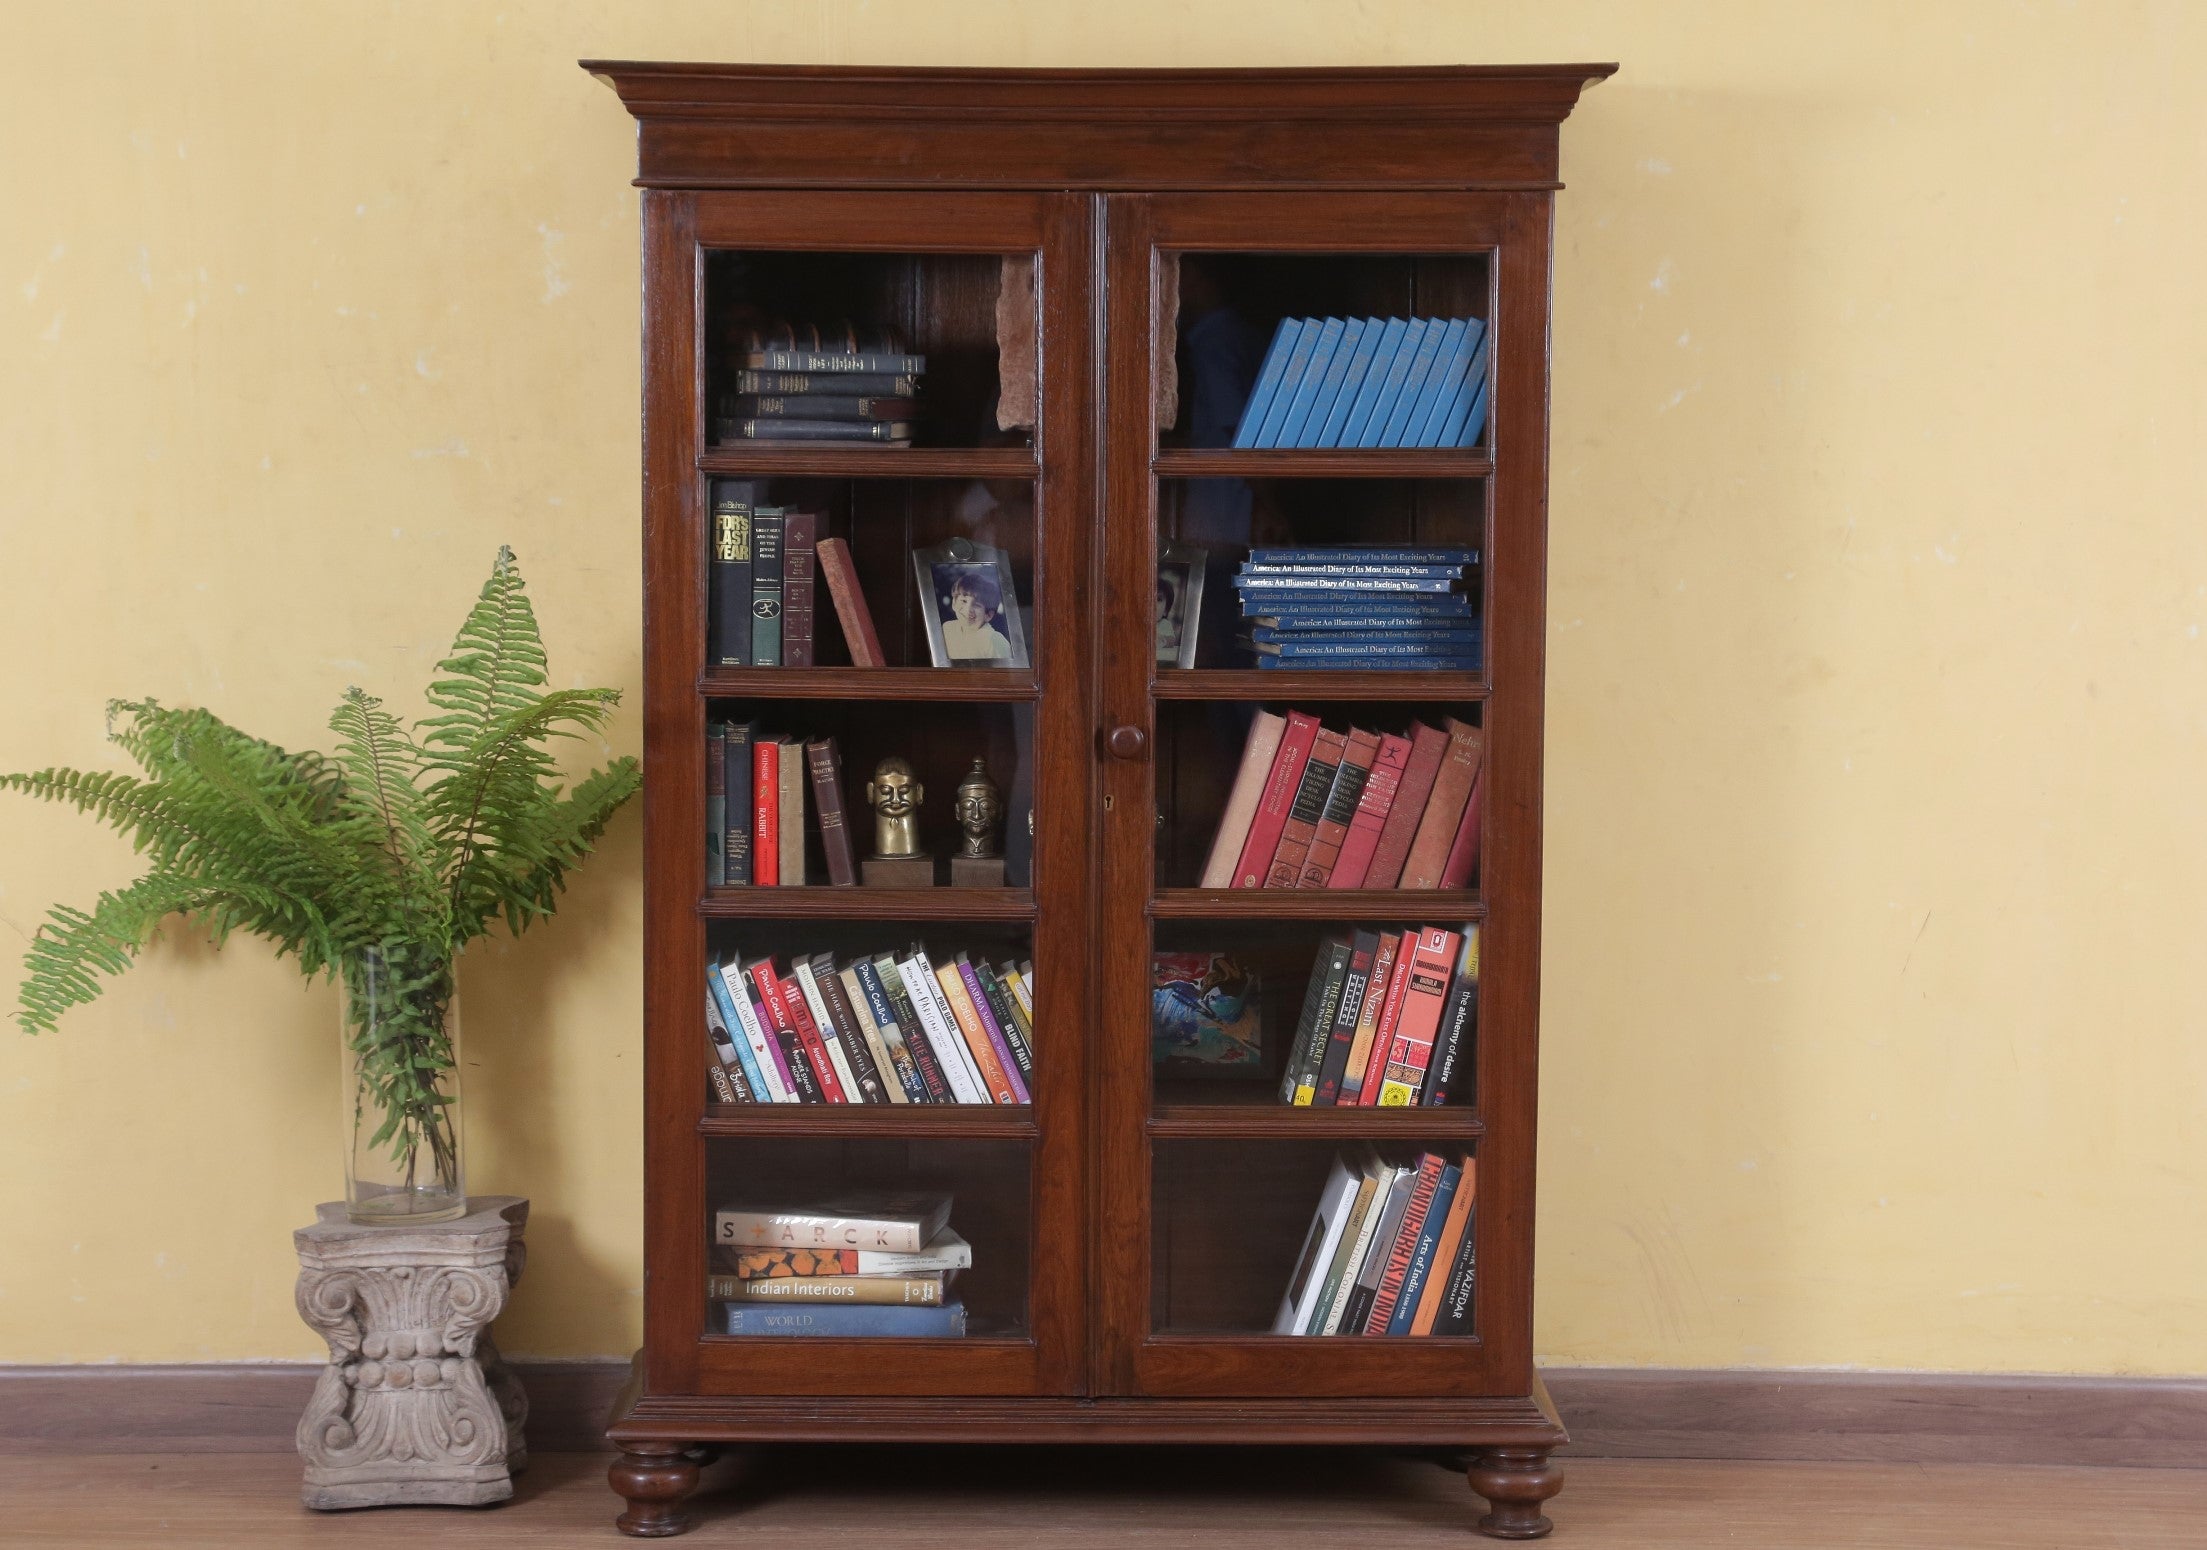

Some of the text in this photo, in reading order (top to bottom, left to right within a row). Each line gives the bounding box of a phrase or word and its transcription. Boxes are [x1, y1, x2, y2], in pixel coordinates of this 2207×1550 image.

[715, 514, 749, 530] FDR's
[727, 501, 747, 510] Bishop
[715, 530, 749, 545] LAST
[715, 544, 749, 560] YEAR
[1252, 564, 1281, 572] America:
[1282, 564, 1292, 572] An
[1293, 564, 1326, 572] Illustrated
[1327, 565, 1346, 575] Diary
[1346, 565, 1355, 573] of
[1355, 565, 1364, 573] Its
[1365, 565, 1382, 573] Most
[1383, 566, 1410, 576] Exciting
[1285, 579, 1318, 587] Illustrated
[1319, 580, 1338, 589] Diary
[1338, 580, 1347, 588] of
[1346, 580, 1356, 588] Its
[1374, 581, 1401, 591] Exciting
[1401, 581, 1419, 589] Years
[1368, 618, 1387, 628] Diary
[1387, 618, 1395, 626] of
[1395, 618, 1405, 626] Its
[1405, 618, 1422, 626] Most
[1295, 645, 1424, 655] America: An Illustrated Diary of Its Most
[761, 749, 769, 781] CHINESE
[758, 807, 767, 839] RABBIT
[1374, 957, 1391, 983] Last
[726, 972, 757, 1037] Paulo Coelho
[758, 968, 786, 1028] Paulo Coelho
[800, 968, 825, 1021] MOHSIN HAMID
[859, 963, 888, 1025] Paulo Coelho
[920, 960, 930, 973] THE
[936, 996, 950, 1014] POLO
[943, 1011, 958, 1032] GAMES
[964, 973, 998, 1043] DHARMA Moments
[1339, 974, 1358, 1026] WRITINGS
[1347, 976, 1367, 1027] THE LOST
[1362, 985, 1385, 1027] Nizam
[1379, 963, 1406, 1048] DREAM WITH YOUR EYES OPEN
[758, 1011, 773, 1042] BUDDHA
[824, 977, 866, 1072] THE HARE WITH AMBER EYES
[918, 996, 940, 1033] PARISIAN
[957, 995, 977, 1032] COELHO
[1312, 980, 1342, 1066] THE GREAT SECRET
[865, 1023, 877, 1043] Tree
[1004, 1023, 1021, 1048] BLIND
[1015, 1047, 1032, 1072] FAITH
[1440, 991, 1471, 1084] the alchemy of desire
[729, 1067, 745, 1099] Brida
[790, 1065, 802, 1084] ALONE
[800, 1070, 813, 1094] STANDS
[812, 1047, 832, 1085] Arundhati Roy
[910, 1033, 928, 1058] KITE
[919, 1056, 944, 1096] RUNNER
[1305, 1073, 1313, 1088] OSH
[1394, 1158, 1443, 1259] CHANDIGARH
[1349, 1229, 1369, 1268] BRITISH
[1408, 1233, 1433, 1293] Arts of India
[1382, 1275, 1404, 1296] IN
[1387, 1257, 1410, 1278] IS
[1448, 1240, 1473, 1305] ARTIST VISIONARY
[746, 1281, 791, 1296] Indian
[793, 1281, 856, 1297] Interiors
[1330, 1271, 1354, 1320] COLONIAL
[1452, 1268, 1476, 1319] VAZIFDAR
[763, 1314, 813, 1327] WORLD
[1364, 1295, 1398, 1337] INDIA
